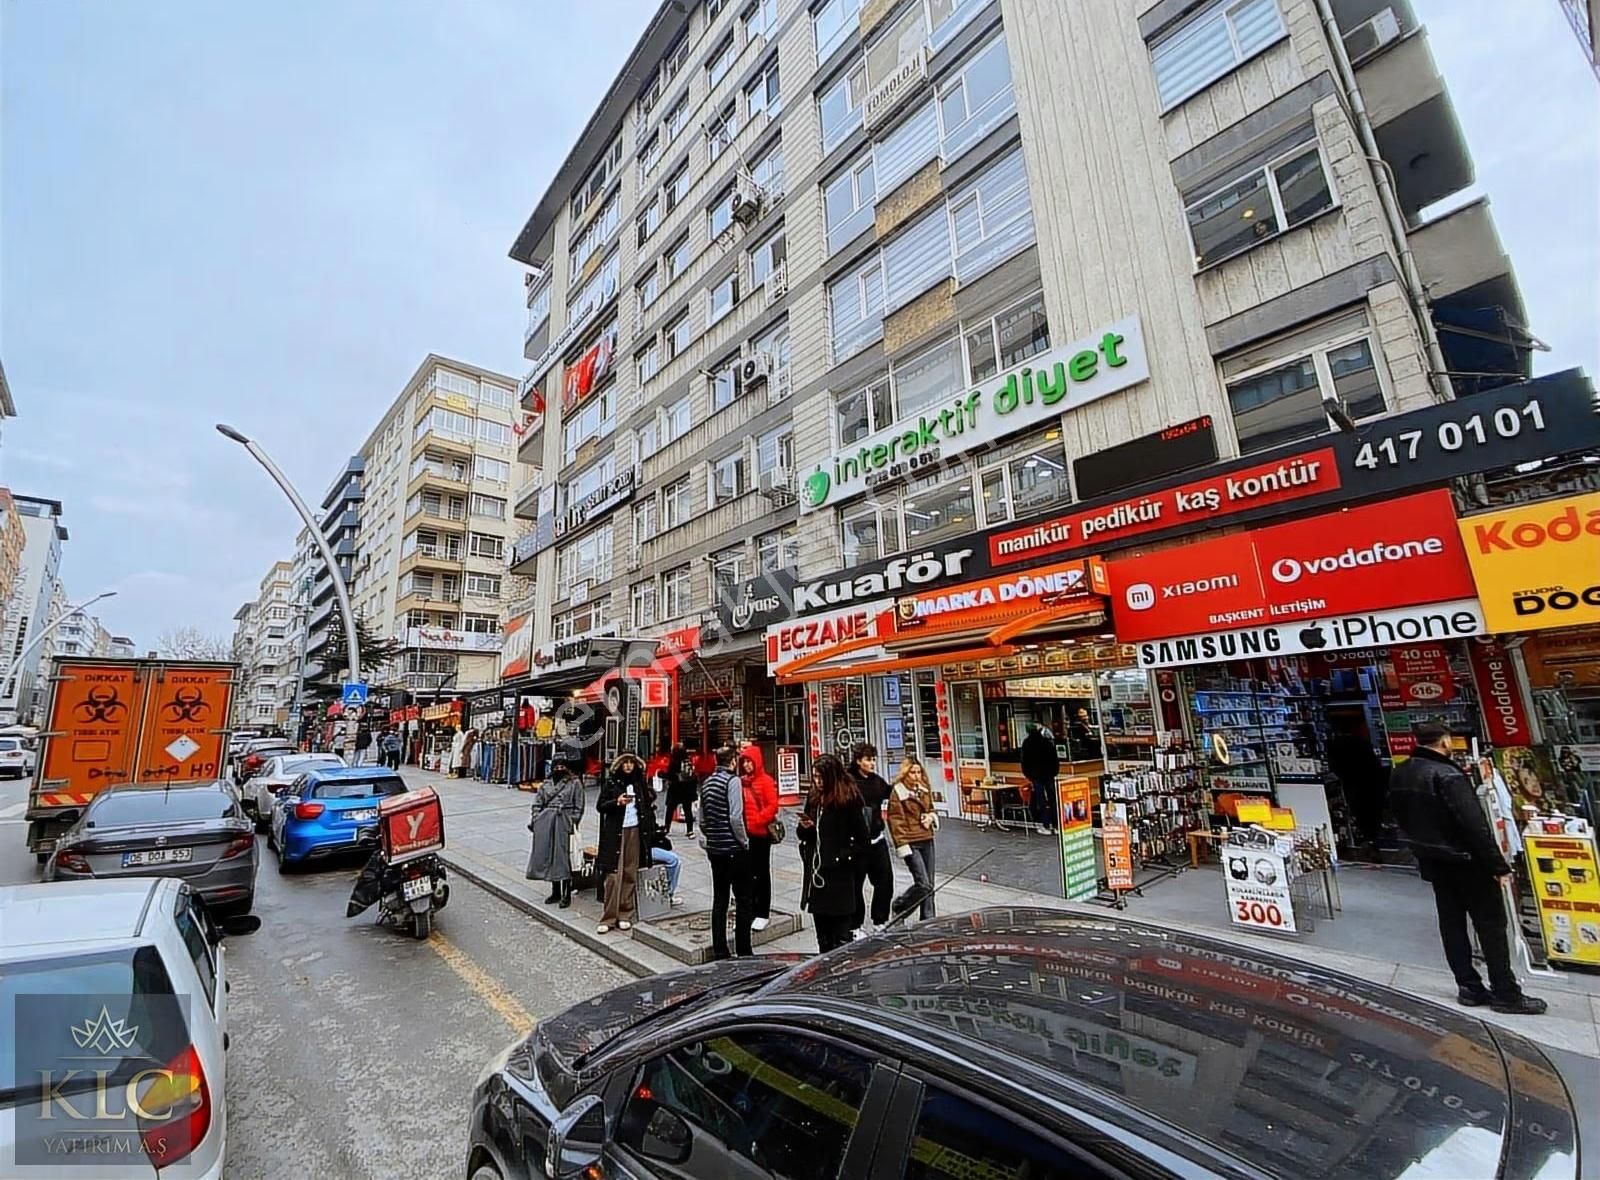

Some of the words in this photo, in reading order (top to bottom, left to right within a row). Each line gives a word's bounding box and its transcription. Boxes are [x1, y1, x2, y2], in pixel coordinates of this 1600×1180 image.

[834, 390, 980, 485] interaktif
[993, 332, 1128, 415] diyet
[1355, 430, 1422, 469] 417
[998, 521, 1070, 555] manikür
[1081, 499, 1162, 540] pedikür
[1176, 486, 1220, 511] kaş
[1226, 459, 1320, 501] kontür
[1303, 536, 1444, 574] vodafone
[793, 549, 972, 611] Kuaför
[916, 587, 996, 617] MARKA
[999, 570, 1085, 601] DÖNER
[1209, 609, 1265, 625] BAŞKENT
[1270, 598, 1326, 616] İLETİŞİM
[1334, 610, 1478, 648] iPhone
[780, 611, 869, 652] ECZANE
[1142, 627, 1280, 666] SAMSUNG
[1488, 661, 1519, 736] vodafone
[190, 763, 214, 777] H9
[406, 812, 425, 839] Y
[1236, 900, 1282, 926] 300
